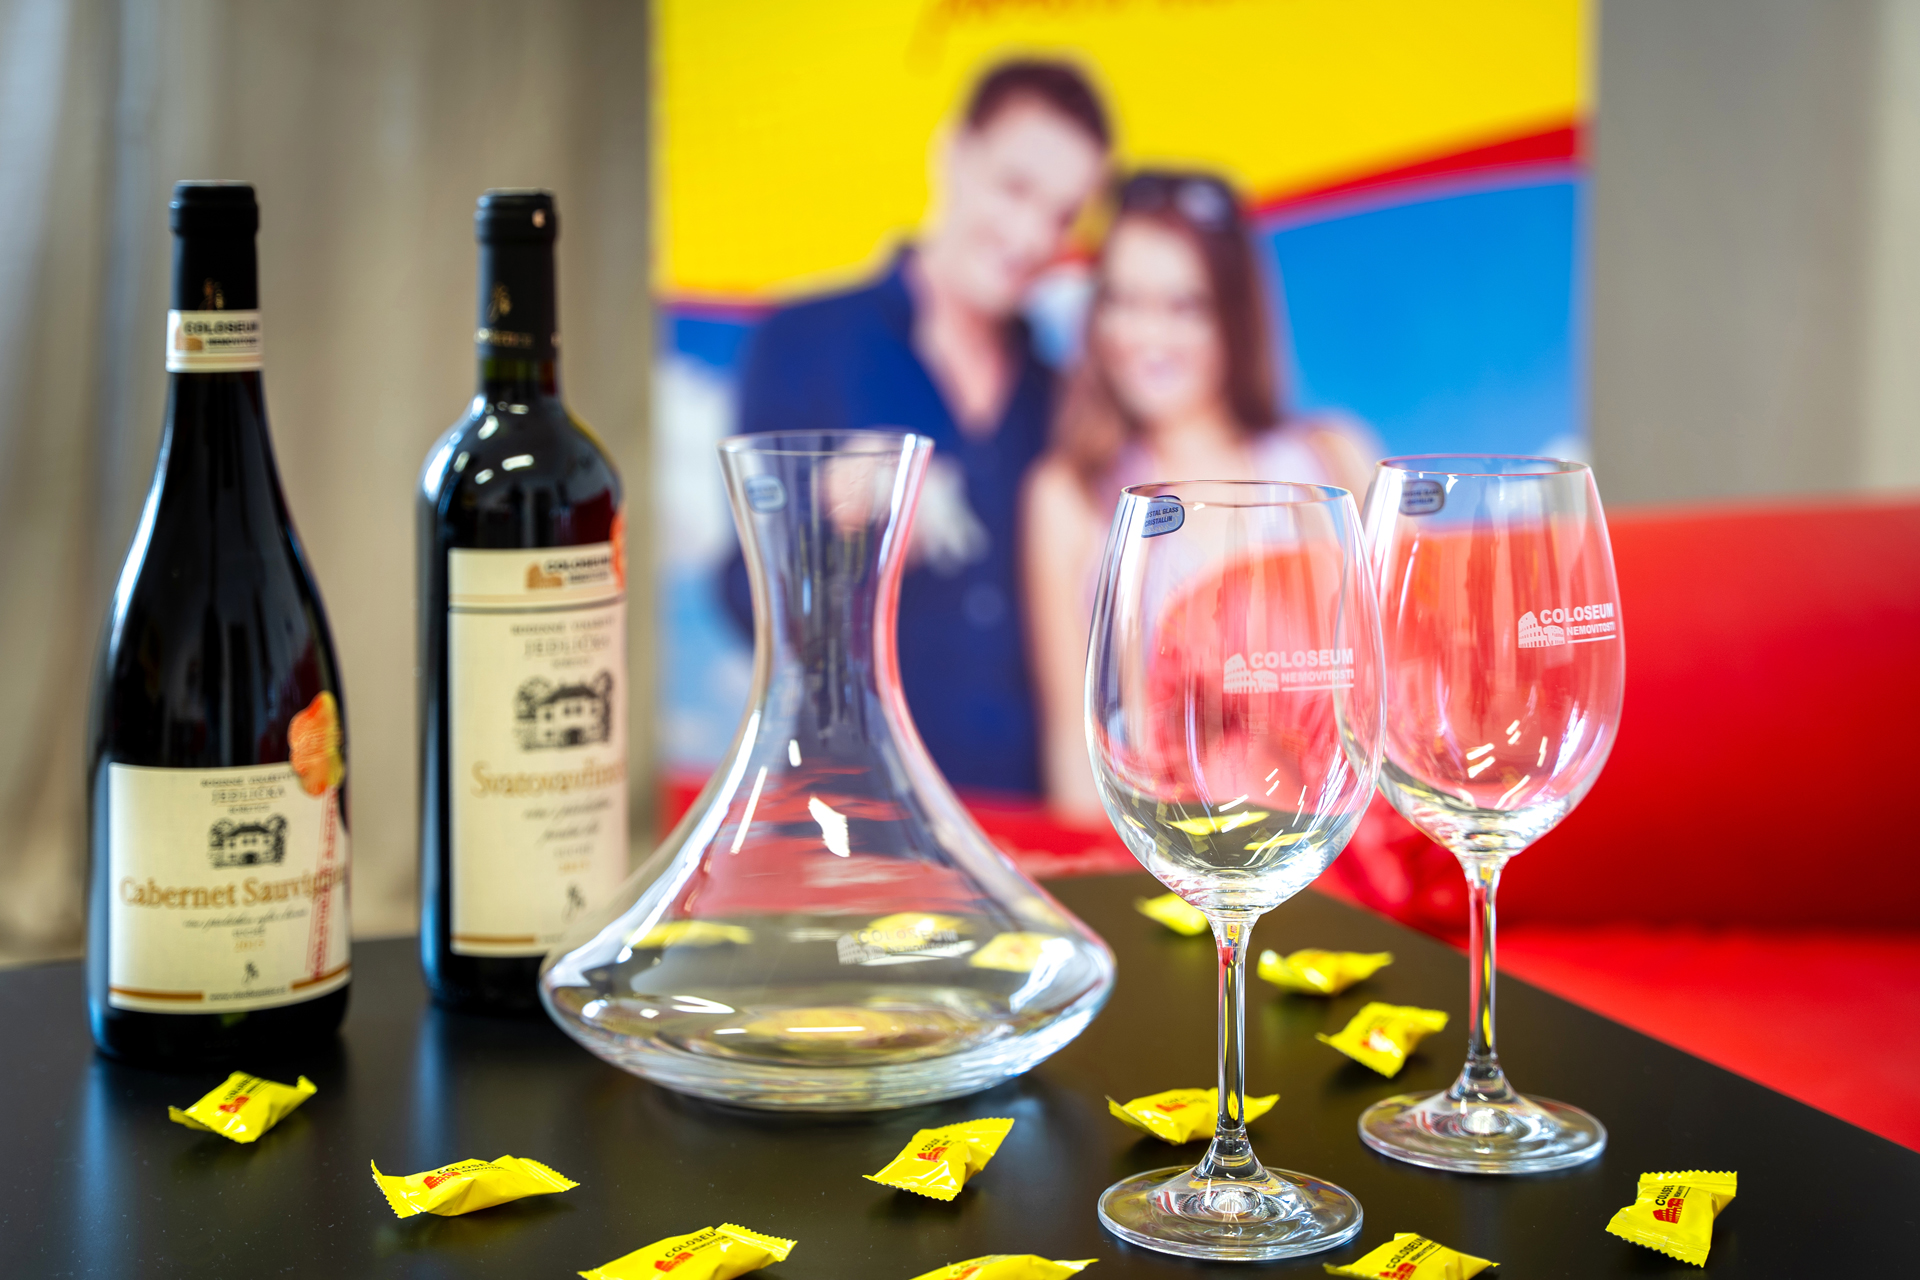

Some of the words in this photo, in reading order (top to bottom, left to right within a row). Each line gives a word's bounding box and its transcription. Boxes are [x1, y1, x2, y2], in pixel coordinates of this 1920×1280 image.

[1162, 506, 1179, 515] GLASS
[1540, 603, 1614, 624] COLOSEUM
[1566, 621, 1616, 636] NEMOVITOSTI
[1250, 648, 1354, 669] COLOSEUM
[1281, 669, 1354, 683] NEMOVITOSTI
[120, 876, 238, 909] Cabernet
[665, 1231, 716, 1258] COLOSEU
